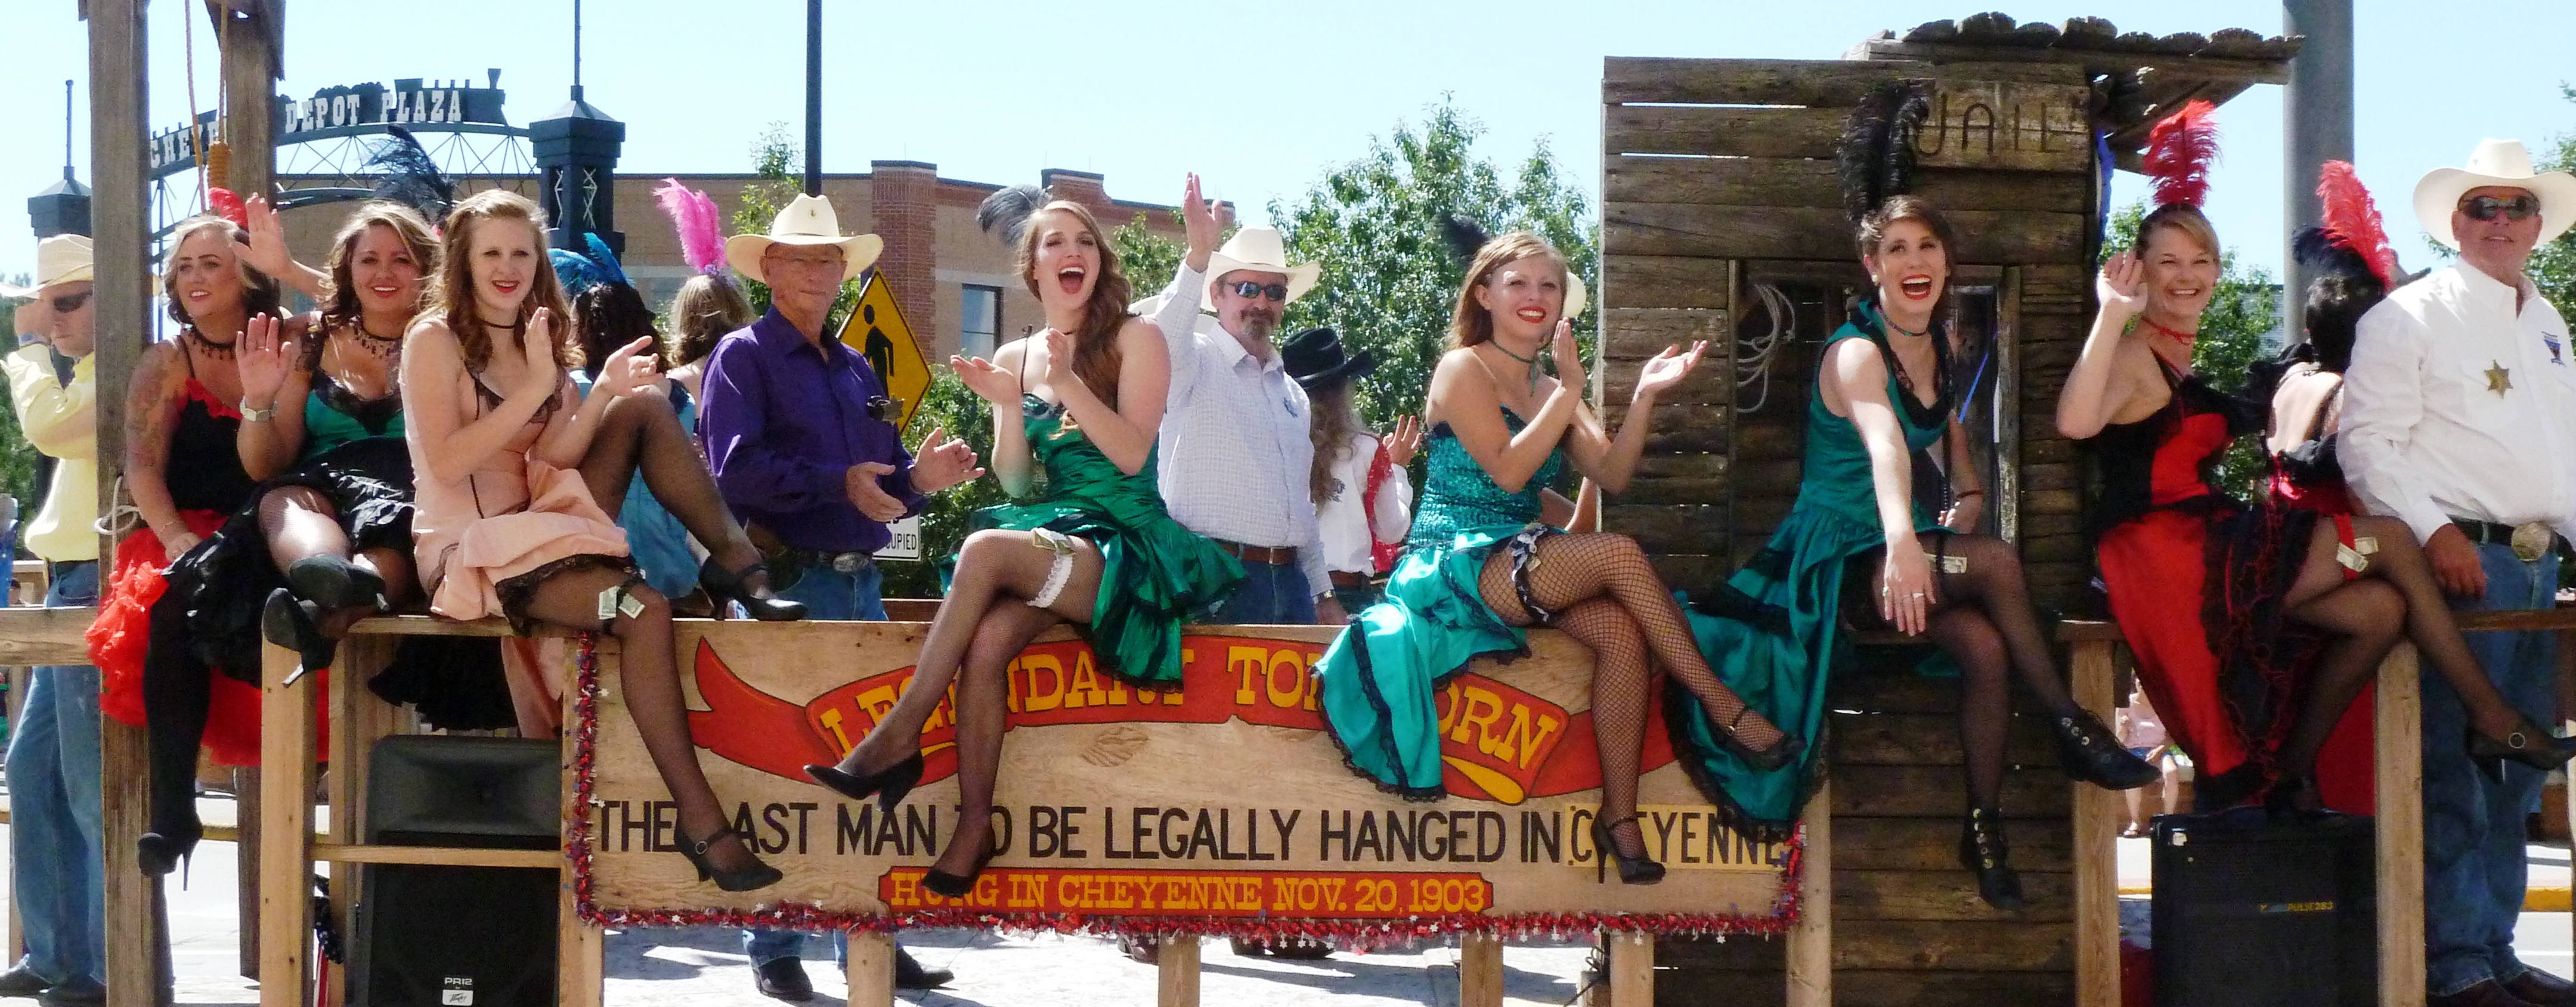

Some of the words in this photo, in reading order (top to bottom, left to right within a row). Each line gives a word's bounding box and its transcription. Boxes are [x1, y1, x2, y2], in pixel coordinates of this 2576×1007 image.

[286, 94, 360, 133] DEPOT
[380, 90, 462, 123] PLAZA
[1916, 92, 2061, 156] JAIL
[886, 533, 917, 550] UPIED
[1438, 683, 1558, 770] ORN
[590, 801, 681, 852] THE
[731, 801, 818, 854] AST
[837, 802, 936, 857] MAN
[954, 805, 1013, 857] O
[1029, 806, 1087, 858] BE
[1104, 807, 1301, 861] LEGALLY
[1320, 810, 1506, 863] HANGED
[1521, 811, 1560, 863] IN
[1571, 810, 1787, 865] CYENN
[891, 872, 999, 907] HG
[1008, 874, 1049, 908] IN
[1058, 875, 1263, 910] CHEYENNE
[1273, 878, 1347, 912] NOV.
[444, 977, 473, 986] PR12
